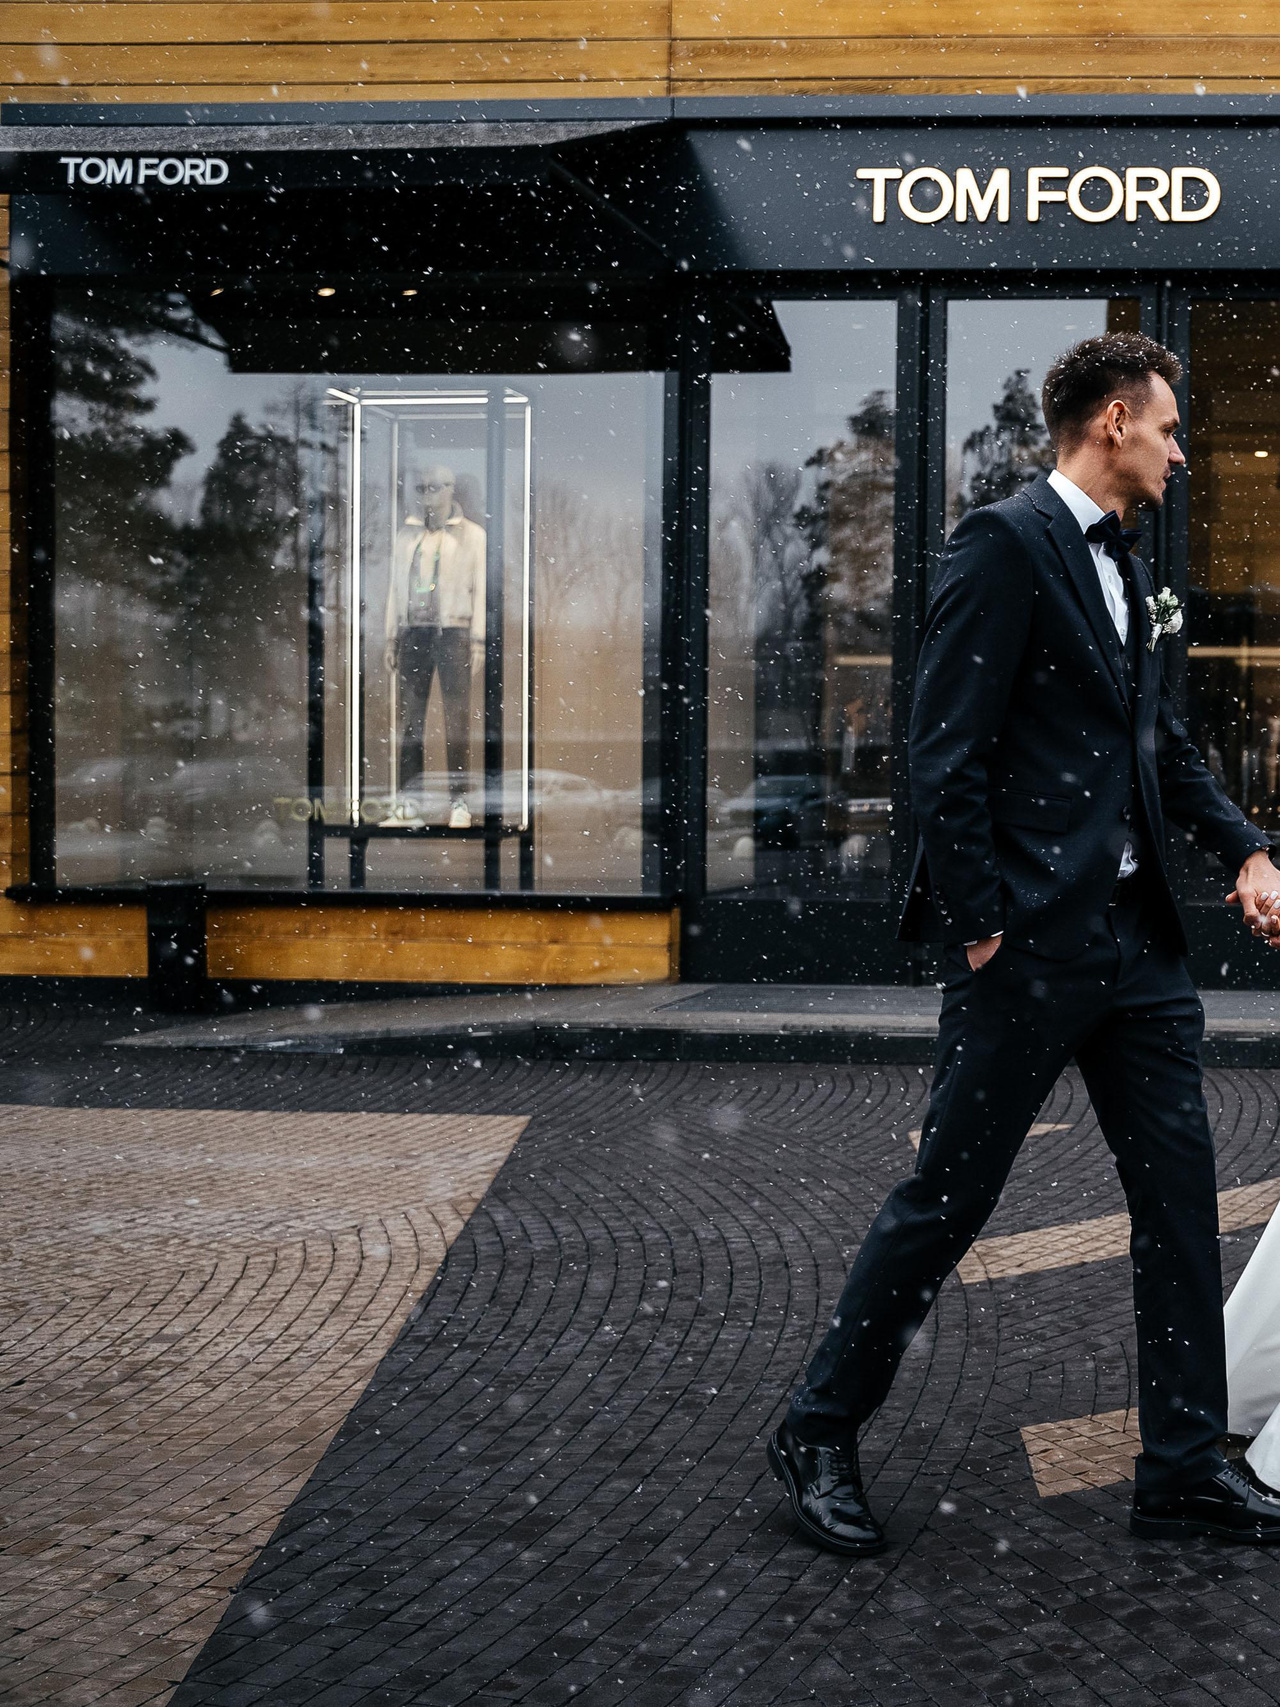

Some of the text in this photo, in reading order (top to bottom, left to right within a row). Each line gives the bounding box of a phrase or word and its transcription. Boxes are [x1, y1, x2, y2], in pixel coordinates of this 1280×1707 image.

[59, 157, 229, 185] TOM FORD
[856, 166, 1221, 224] TOM FORD
